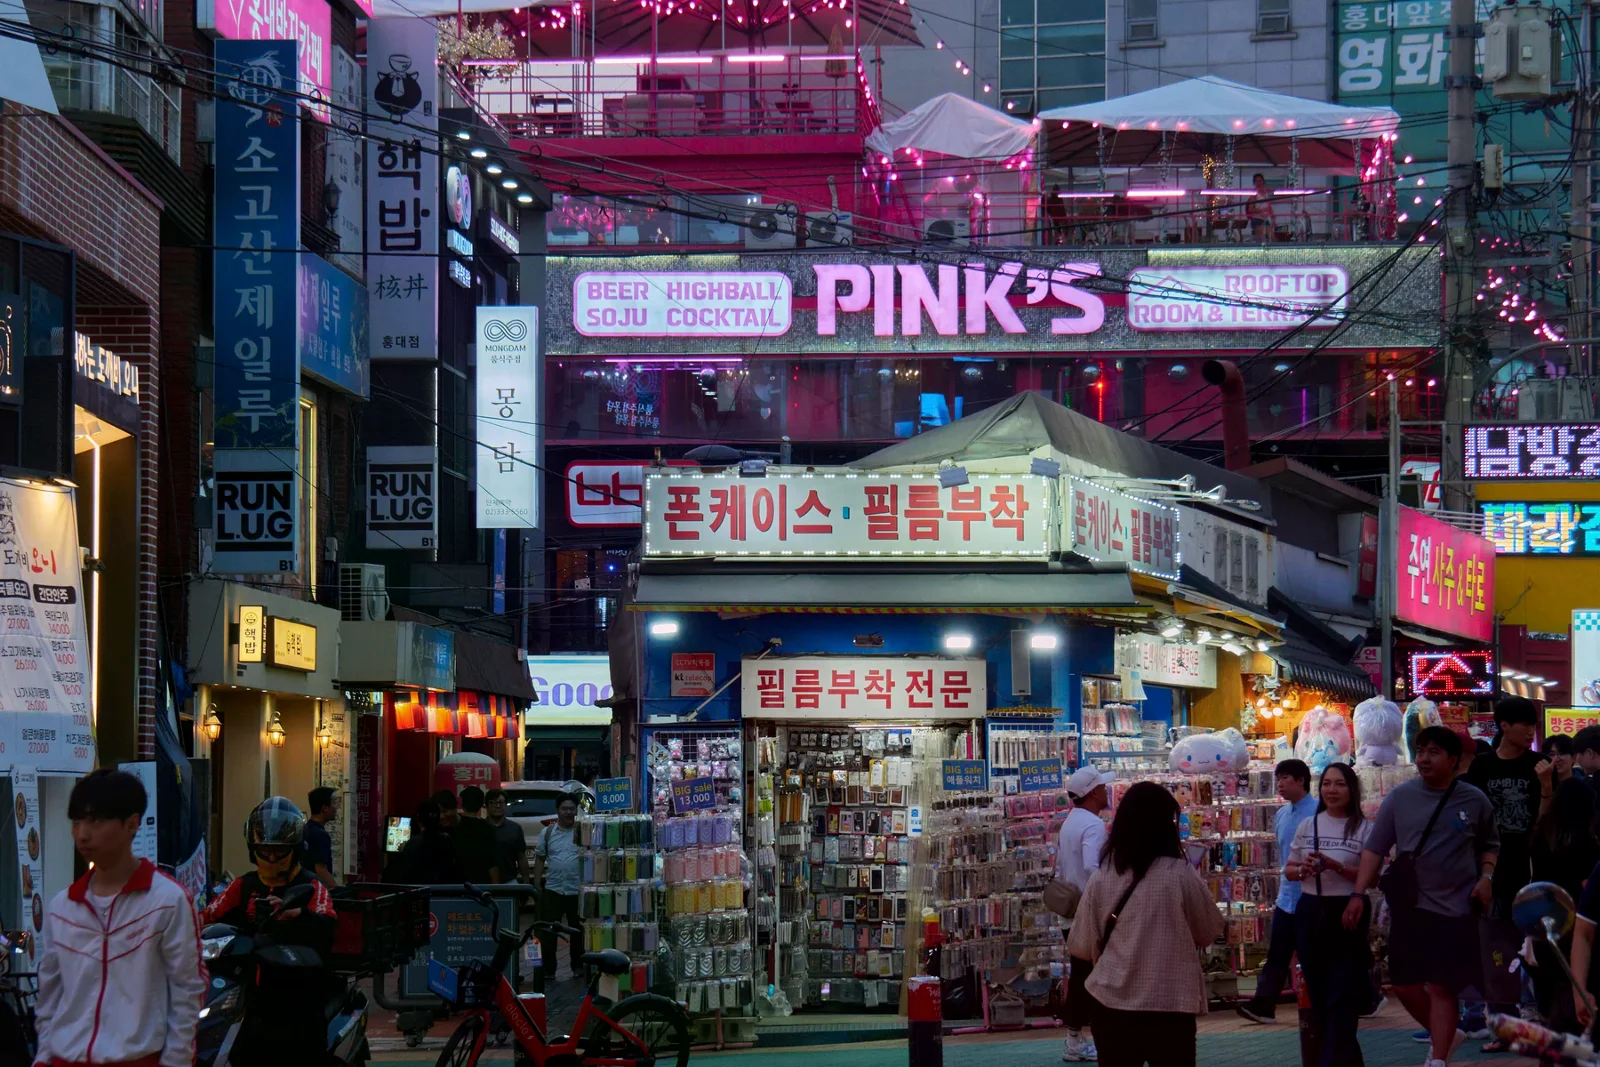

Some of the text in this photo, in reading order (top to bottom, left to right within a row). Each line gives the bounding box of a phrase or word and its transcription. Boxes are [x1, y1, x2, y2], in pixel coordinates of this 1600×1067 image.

[377, 139, 430, 251] 핵밥
[232, 136, 279, 434] 소고산제일루
[587, 282, 782, 300] BEER HIGHBALL
[1225, 274, 1339, 293] ROOFTOP
[813, 262, 1105, 336] PINK'S
[587, 308, 781, 327] SOJU COCKTAIL
[1134, 303, 1331, 323] ROOM & TERRA
[382, 335, 420, 349] 홍대점
[491, 388, 521, 474] 몽담
[370, 474, 431, 496] RUN
[217, 483, 291, 510] RUN
[370, 499, 433, 521] L.U.G
[217, 511, 293, 540] L.U.G
[422, 537, 434, 546] B1
[31, 547, 57, 575] 오니
[279, 560, 293, 571] B1
[1407, 533, 1431, 605] 주연
[39, 587, 69, 602] 간단안주
[244, 628, 257, 654] 핵밥
[675, 673, 684, 681] kt
[453, 767, 493, 781] 홍대
[945, 766, 982, 774] BIG sale
[1022, 765, 1059, 775] BIG sale
[598, 782, 629, 793] BIG sale
[674, 782, 712, 796] BIG sale
[946, 775, 981, 785] 애플워치
[602, 793, 625, 804] 8,000
[679, 792, 710, 806] 13,000
[447, 912, 483, 921] 레드로드
